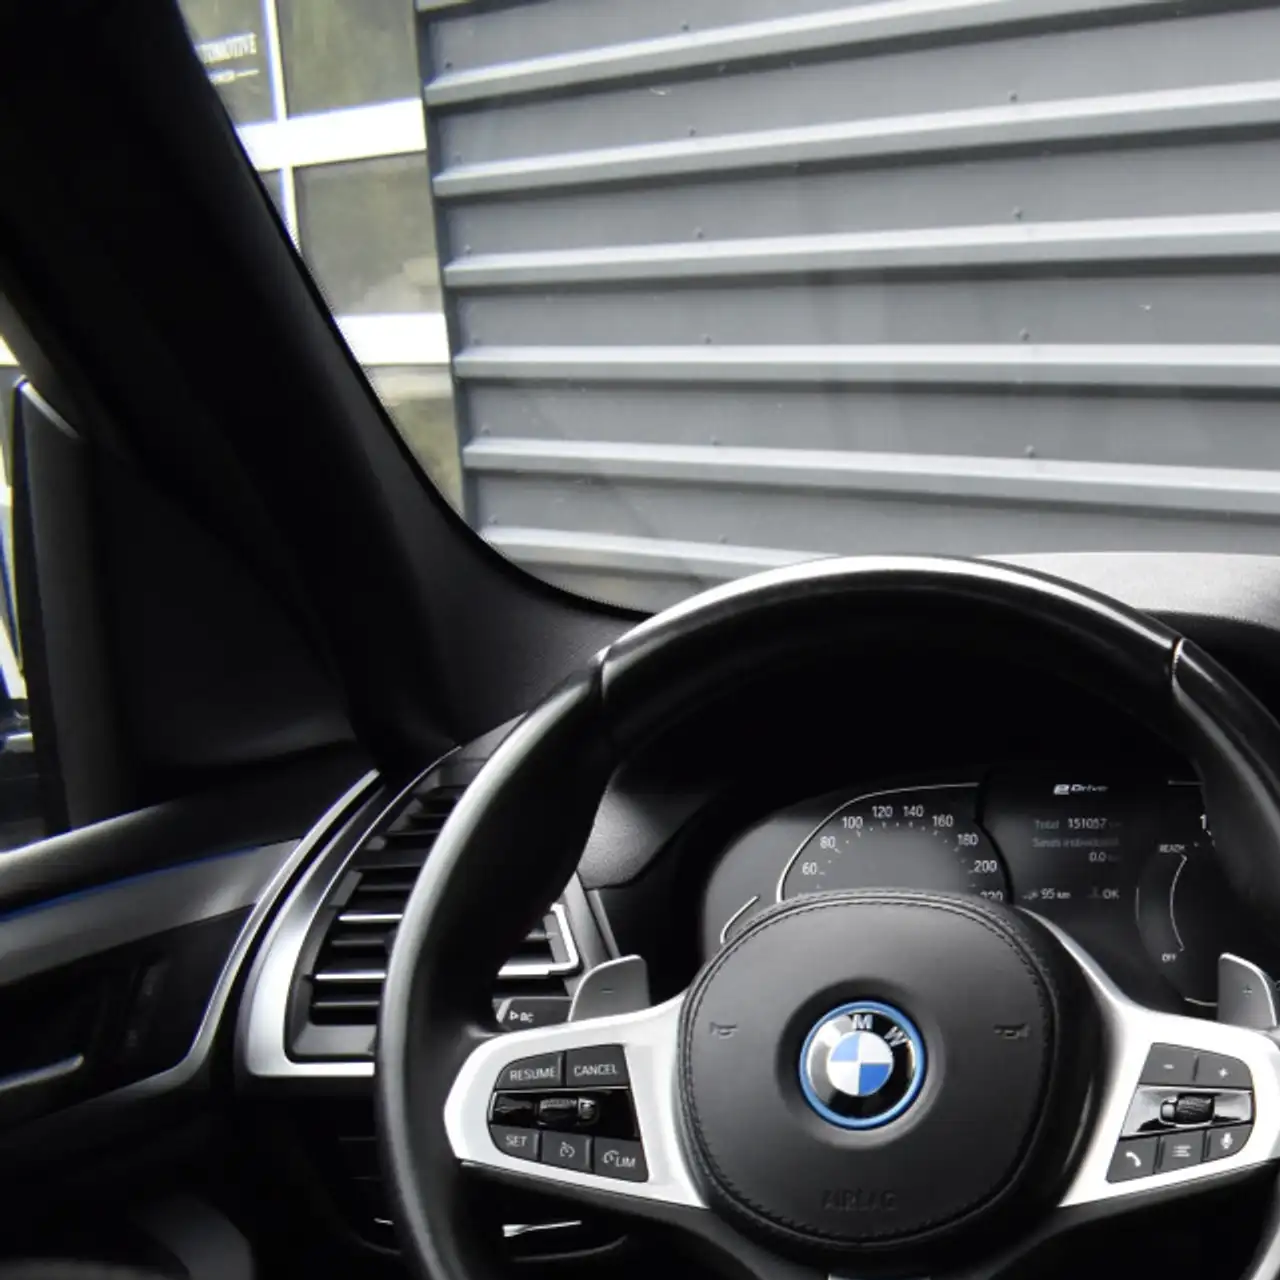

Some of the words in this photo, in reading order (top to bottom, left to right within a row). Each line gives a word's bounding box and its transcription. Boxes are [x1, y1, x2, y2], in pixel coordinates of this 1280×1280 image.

[872, 806, 893, 818] 120
[903, 805, 924, 818] 140
[841, 816, 864, 829] 100
[932, 815, 954, 828] 160
[819, 835, 837, 849] 80
[957, 833, 979, 847] 180
[801, 862, 818, 876] 60
[974, 860, 998, 873] 200
[509, 1067, 557, 1082] RESUME
[573, 1063, 619, 1077] CANCEL
[505, 1134, 528, 1147] SET
[615, 1156, 636, 1168] LIM
